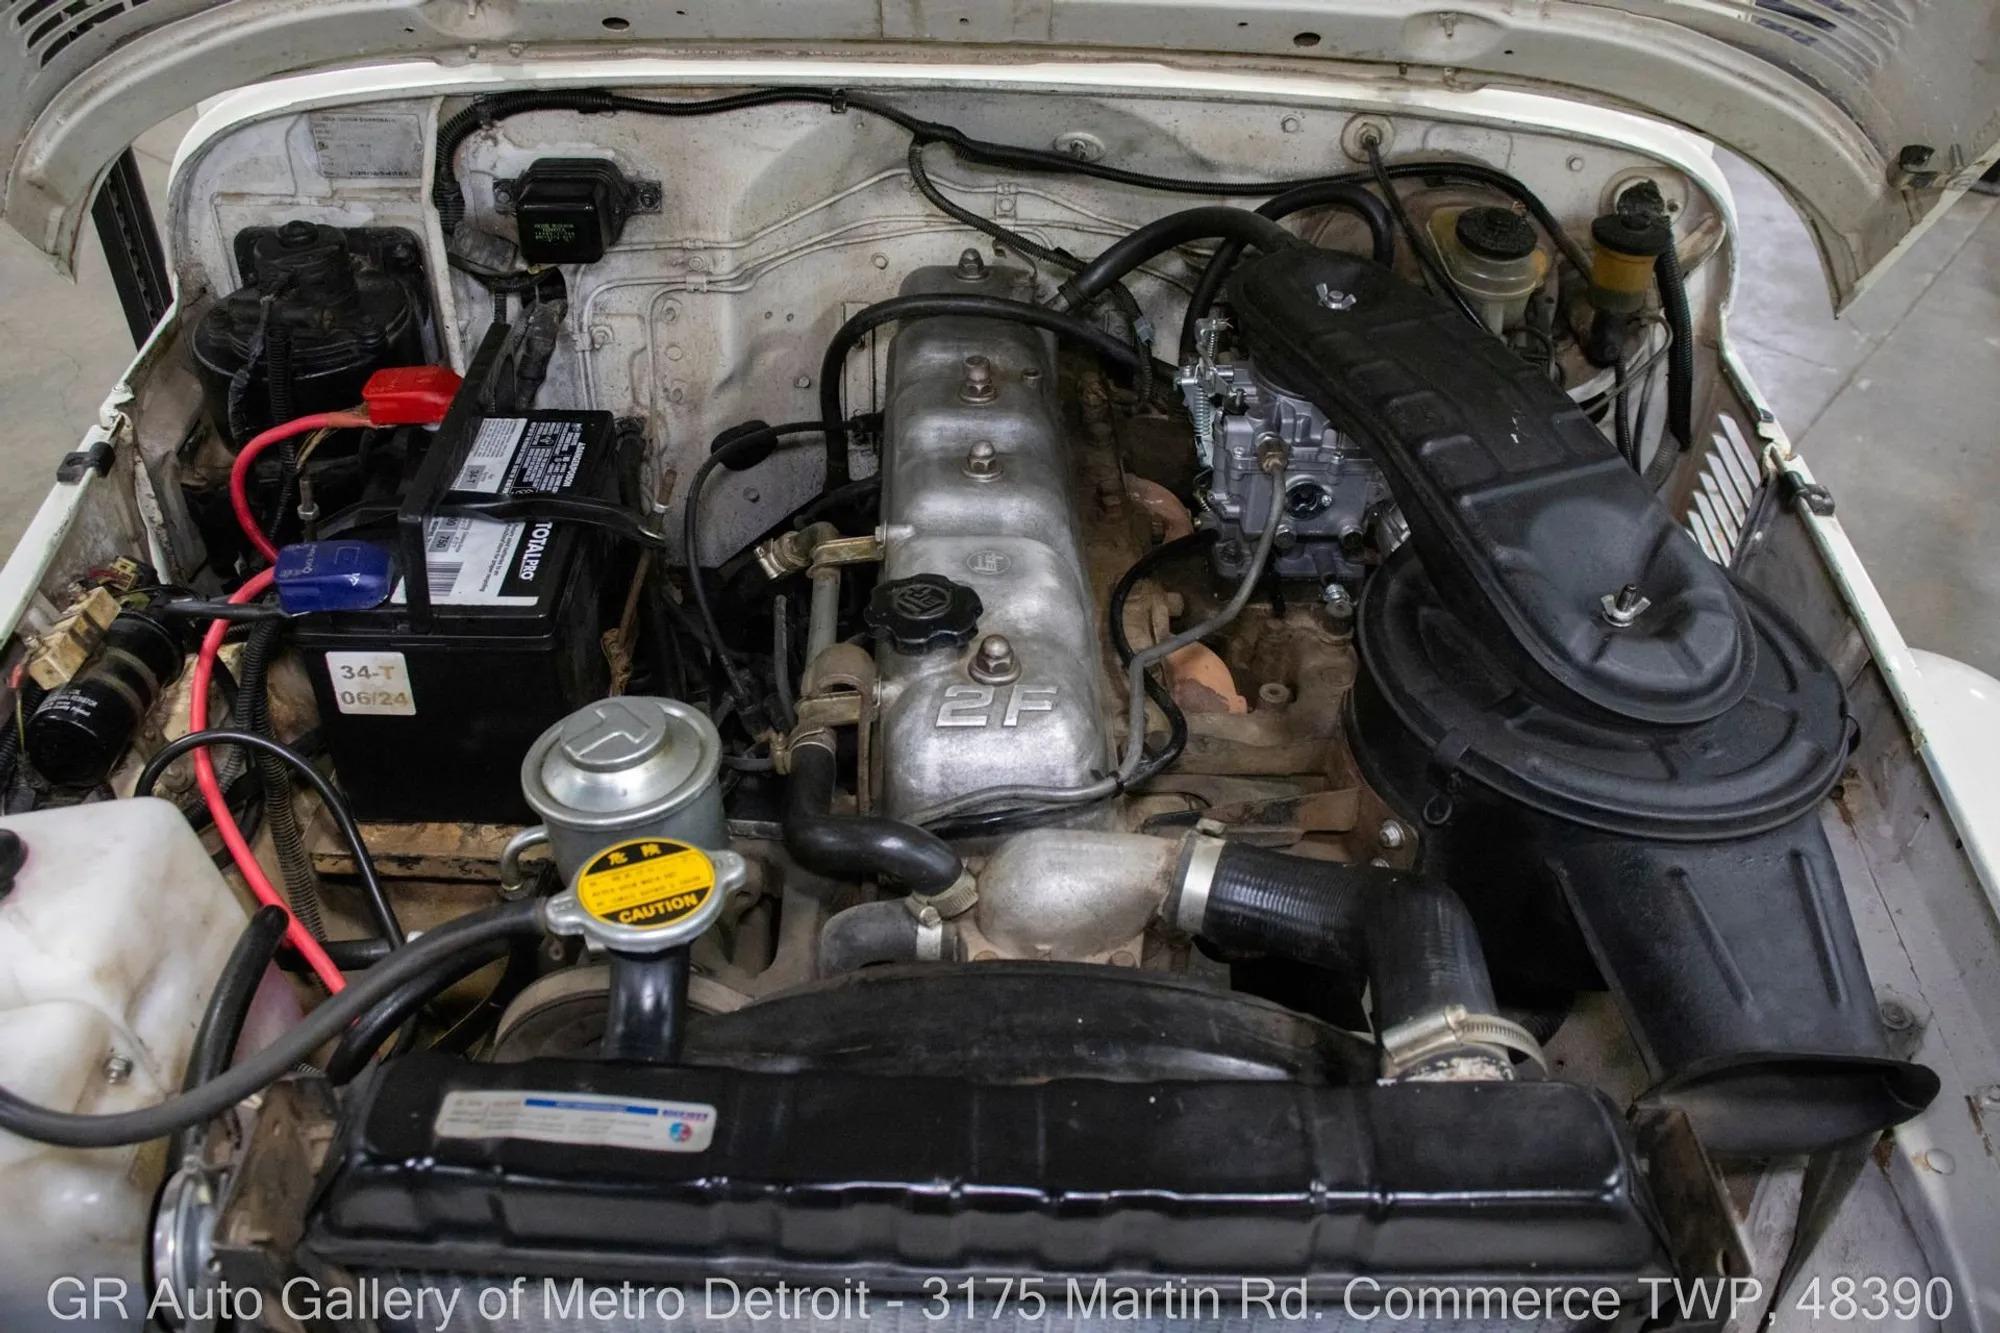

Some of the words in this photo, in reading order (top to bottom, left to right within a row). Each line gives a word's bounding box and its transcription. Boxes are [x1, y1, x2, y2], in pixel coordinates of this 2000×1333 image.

[519, 521, 554, 581] TOTALPRO
[340, 665, 395, 680] 34-T
[340, 690, 409, 706] 06/24
[935, 684, 1059, 728] 2F
[618, 893, 699, 925] CAUTION
